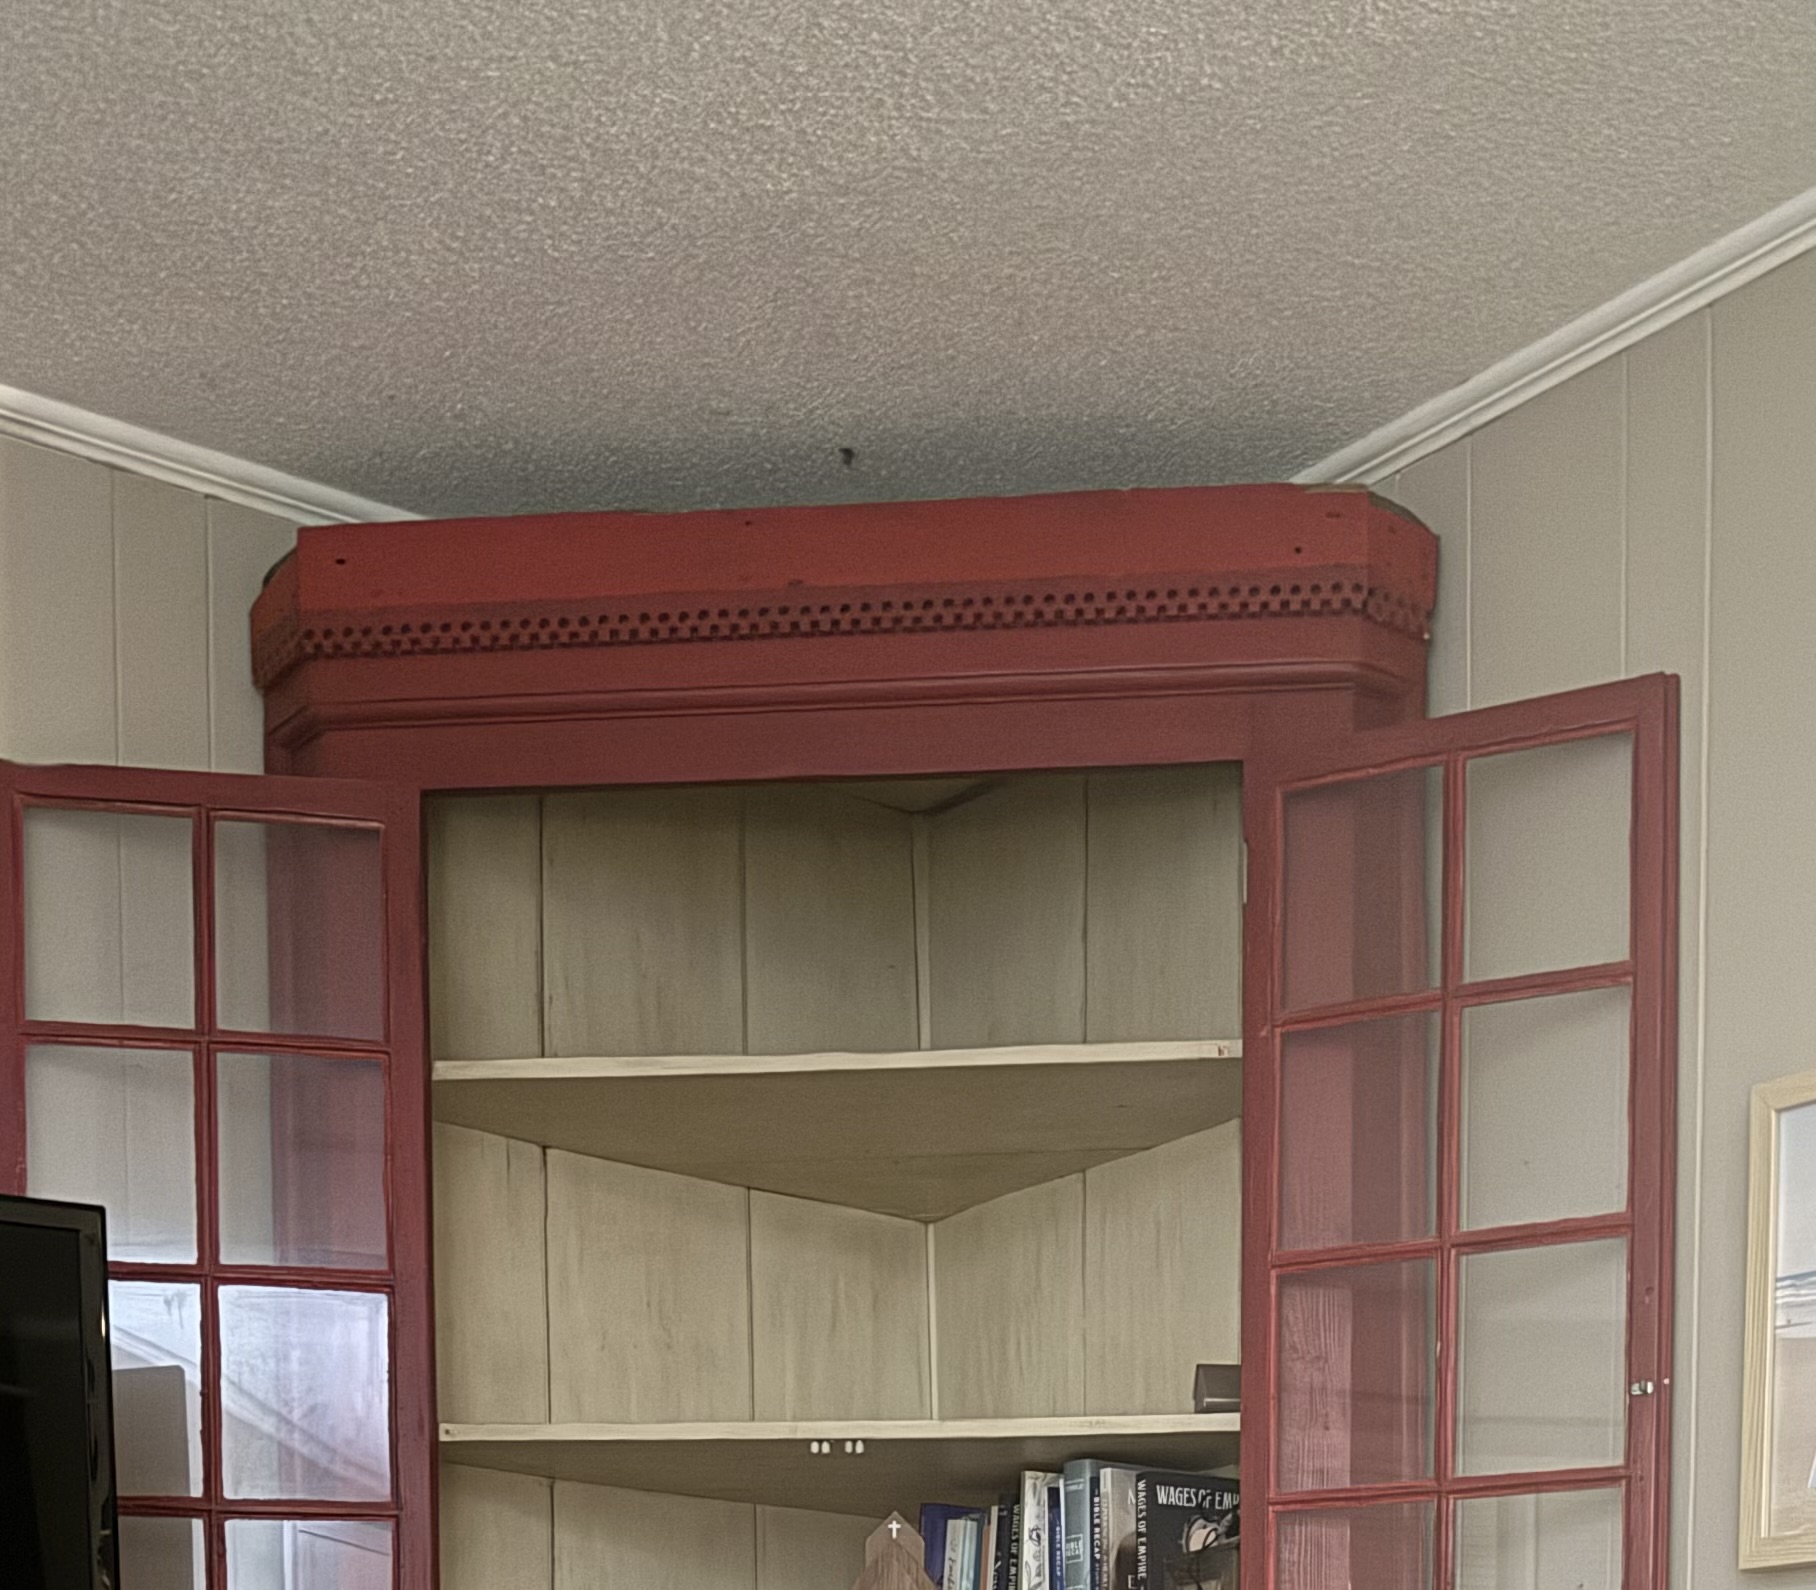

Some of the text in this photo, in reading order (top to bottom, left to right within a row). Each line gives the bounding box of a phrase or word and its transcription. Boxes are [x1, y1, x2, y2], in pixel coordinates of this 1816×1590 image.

[1093, 1496, 1101, 1525] BIBLE
[1137, 1479, 1147, 1519] WAGES
[1156, 1485, 1197, 1507] WAGES
[1011, 1503, 1021, 1540] WAGES
[1137, 1520, 1147, 1534] OF
[1093, 1527, 1101, 1560] RECAP
[1137, 1537, 1147, 1580] EMPIRE
